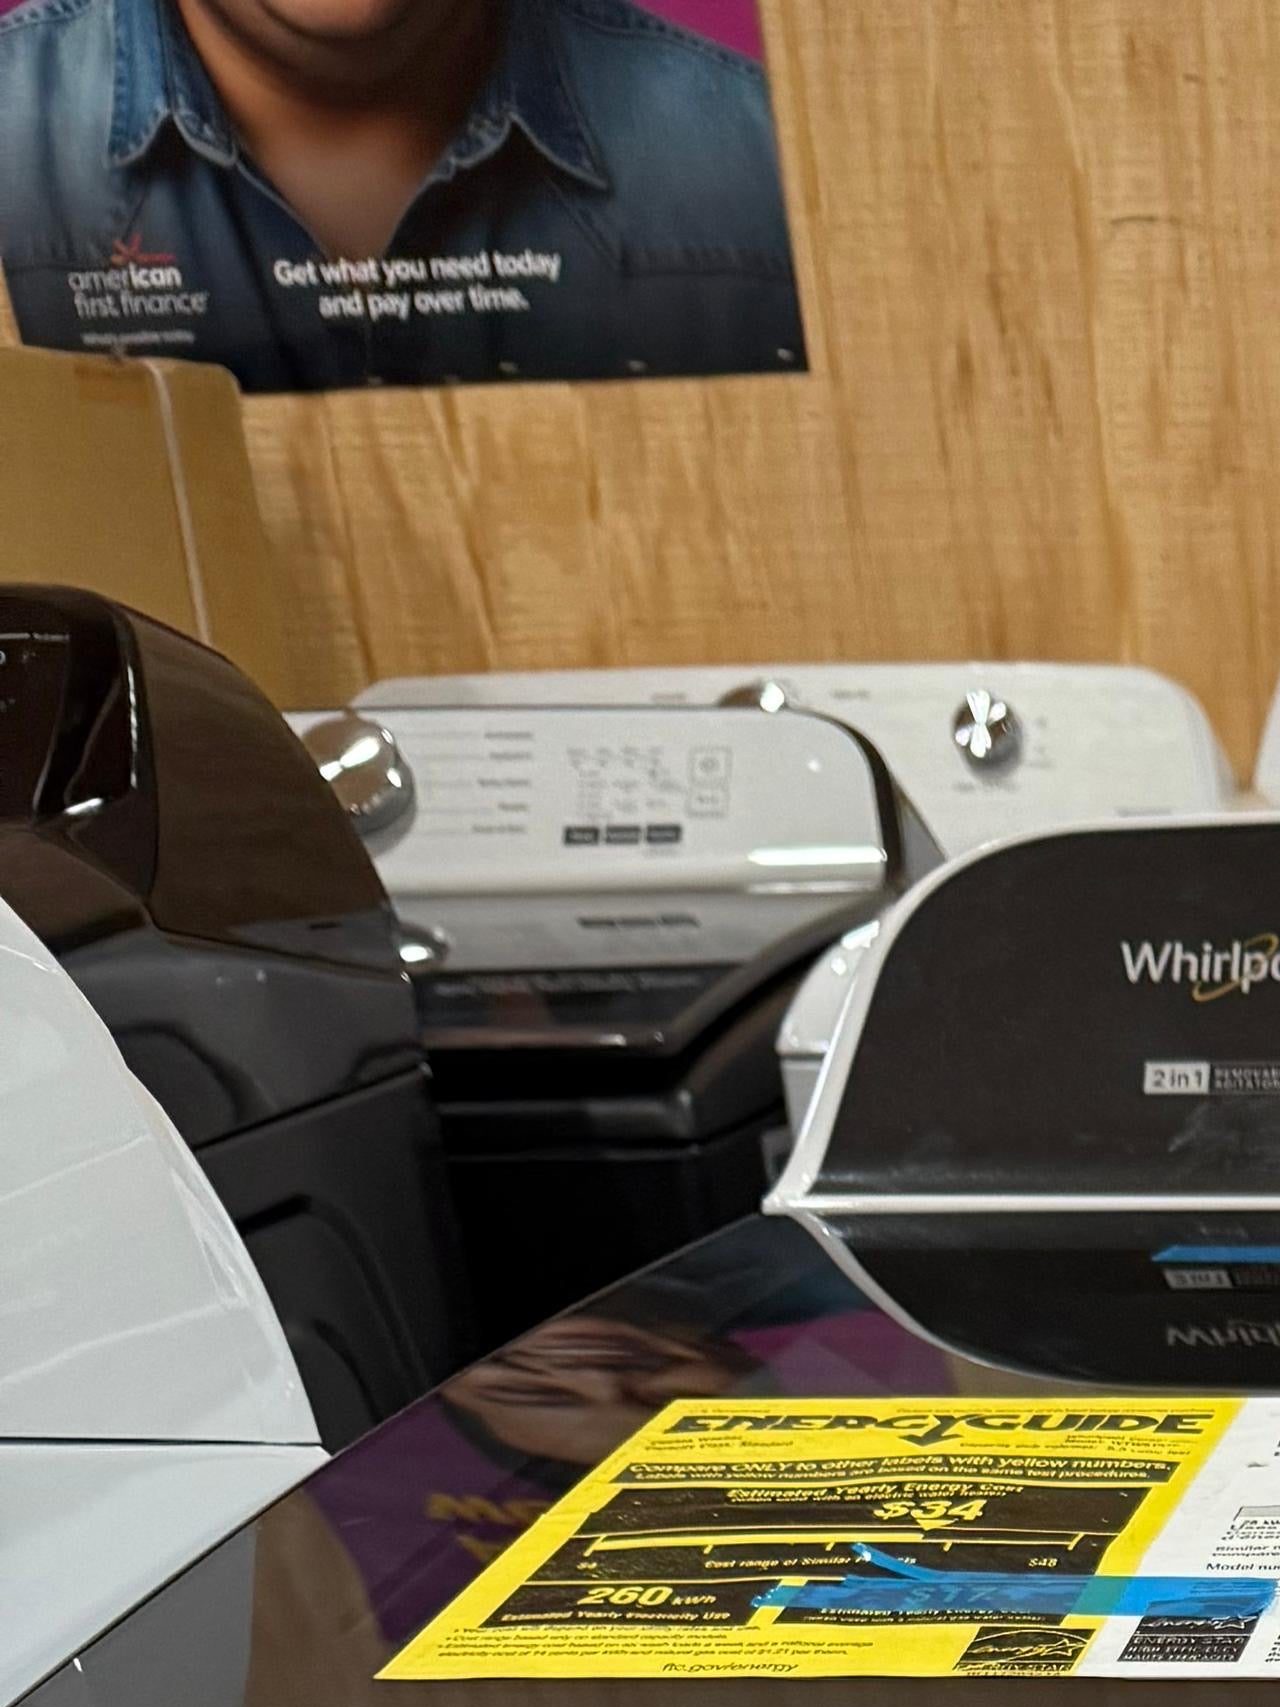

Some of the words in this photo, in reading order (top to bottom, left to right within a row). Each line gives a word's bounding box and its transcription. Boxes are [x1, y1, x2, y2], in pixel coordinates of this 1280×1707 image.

[67, 262, 182, 292] american
[273, 259, 319, 285] Get
[319, 257, 380, 286] what
[382, 258, 428, 287] you
[429, 249, 491, 280] need
[493, 249, 561, 281] today
[74, 291, 119, 319] first
[319, 290, 364, 320] and
[366, 293, 410, 322] pay
[413, 290, 466, 314] over
[468, 283, 530, 312] time.
[1153, 1069, 1167, 1088] 2
[1169, 1069, 1190, 1088] in
[1192, 1069, 1204, 1088] 1
[662, 1412, 1214, 1448] ENERGYGUIDE
[629, 1463, 727, 1473] Compare
[730, 1463, 795, 1472] ONLY
[796, 1462, 818, 1471] to
[820, 1460, 879, 1470] other
[881, 1456, 943, 1467] labels
[948, 1456, 994, 1465] with
[997, 1458, 1071, 1468] yellow
[727, 1488, 828, 1498] Estimated
[835, 1484, 898, 1494] Yearly
[902, 1483, 973, 1493] Energy
[979, 1484, 1025, 1493] Cost
[872, 1499, 987, 1521] $34
[704, 1559, 736, 1568] Cost
[801, 1556, 852, 1566] Similar
[1028, 1558, 1058, 1568] $48
[576, 1586, 673, 1606] 260
[671, 1594, 717, 1606] kWh
[501, 1611, 574, 1621] Estimated
[577, 1610, 622, 1620] Yearly
[702, 1611, 731, 1619] Use
